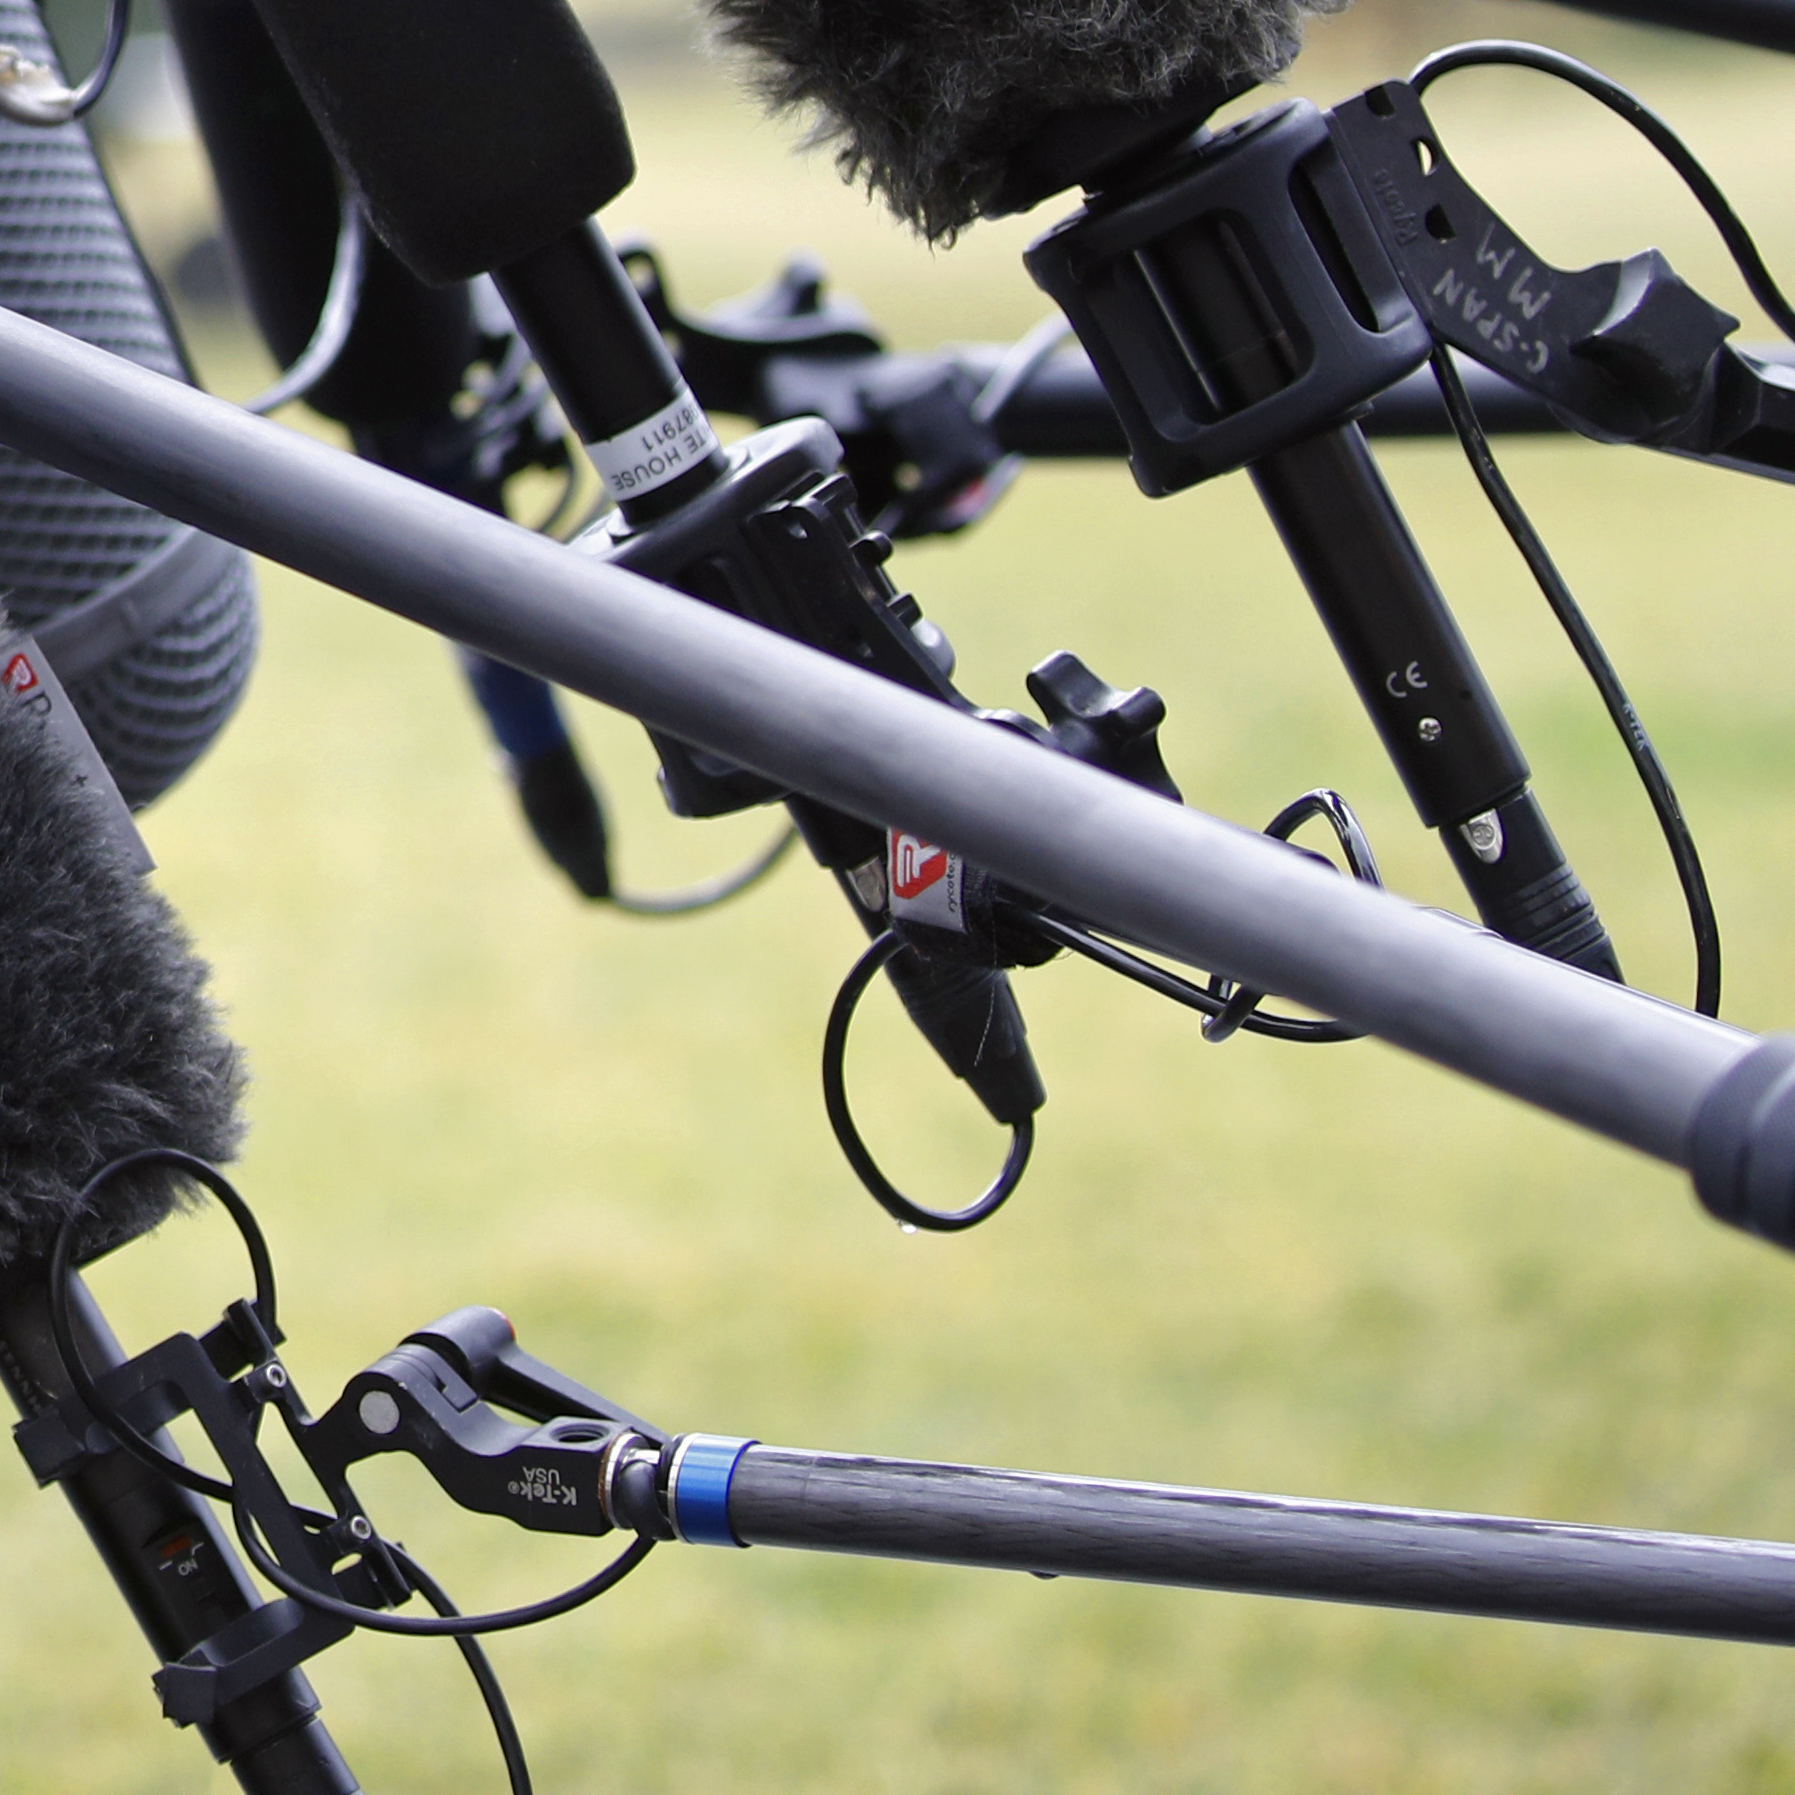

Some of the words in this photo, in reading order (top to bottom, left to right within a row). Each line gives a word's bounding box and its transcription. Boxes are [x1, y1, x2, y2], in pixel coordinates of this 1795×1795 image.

[1433, 268, 1549, 373] C-SPAN
[611, 447, 682, 491] HOUSE
[1386, 660, 1428, 698] CE
[522, 1466, 560, 1485] USA
[178, 1558, 198, 1576] ON
